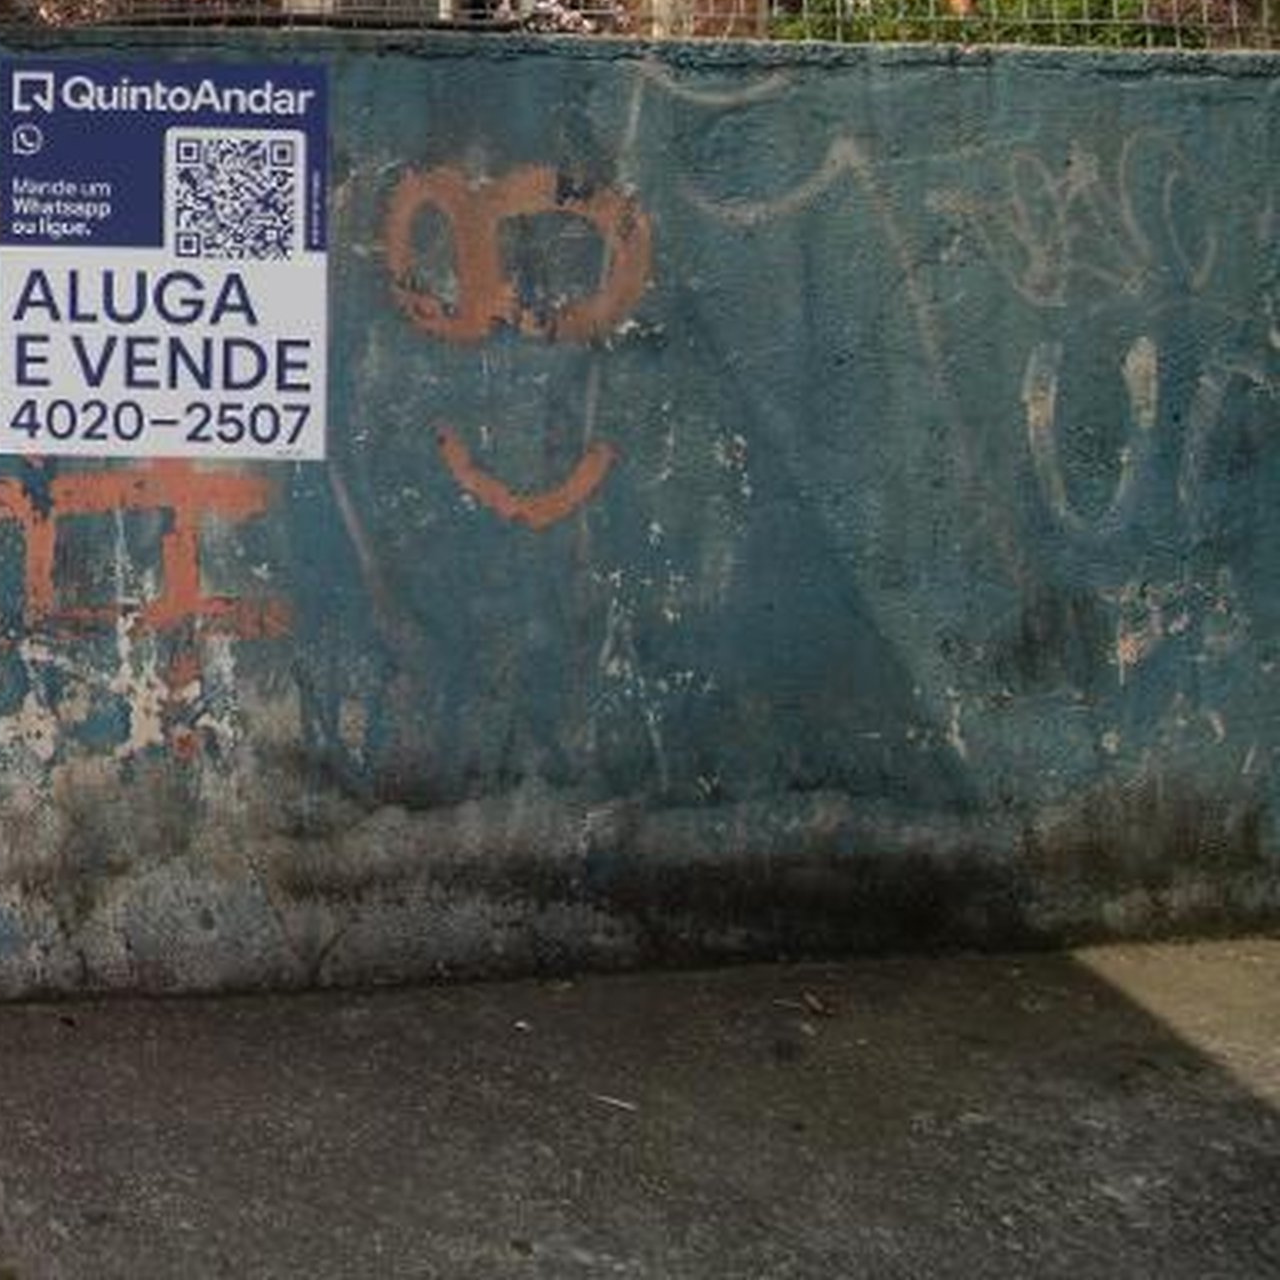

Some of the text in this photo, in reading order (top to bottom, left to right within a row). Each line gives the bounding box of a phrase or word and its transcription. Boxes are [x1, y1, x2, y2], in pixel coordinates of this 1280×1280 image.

[62, 75, 314, 115] QuintoAndar
[12, 178, 112, 197] Mande um
[12, 197, 112, 219] Whatsapp
[12, 221, 37, 234] ou
[13, 269, 258, 326] ALUGA
[15, 335, 312, 392] E VENDE
[10, 398, 312, 444] 4020-2507
